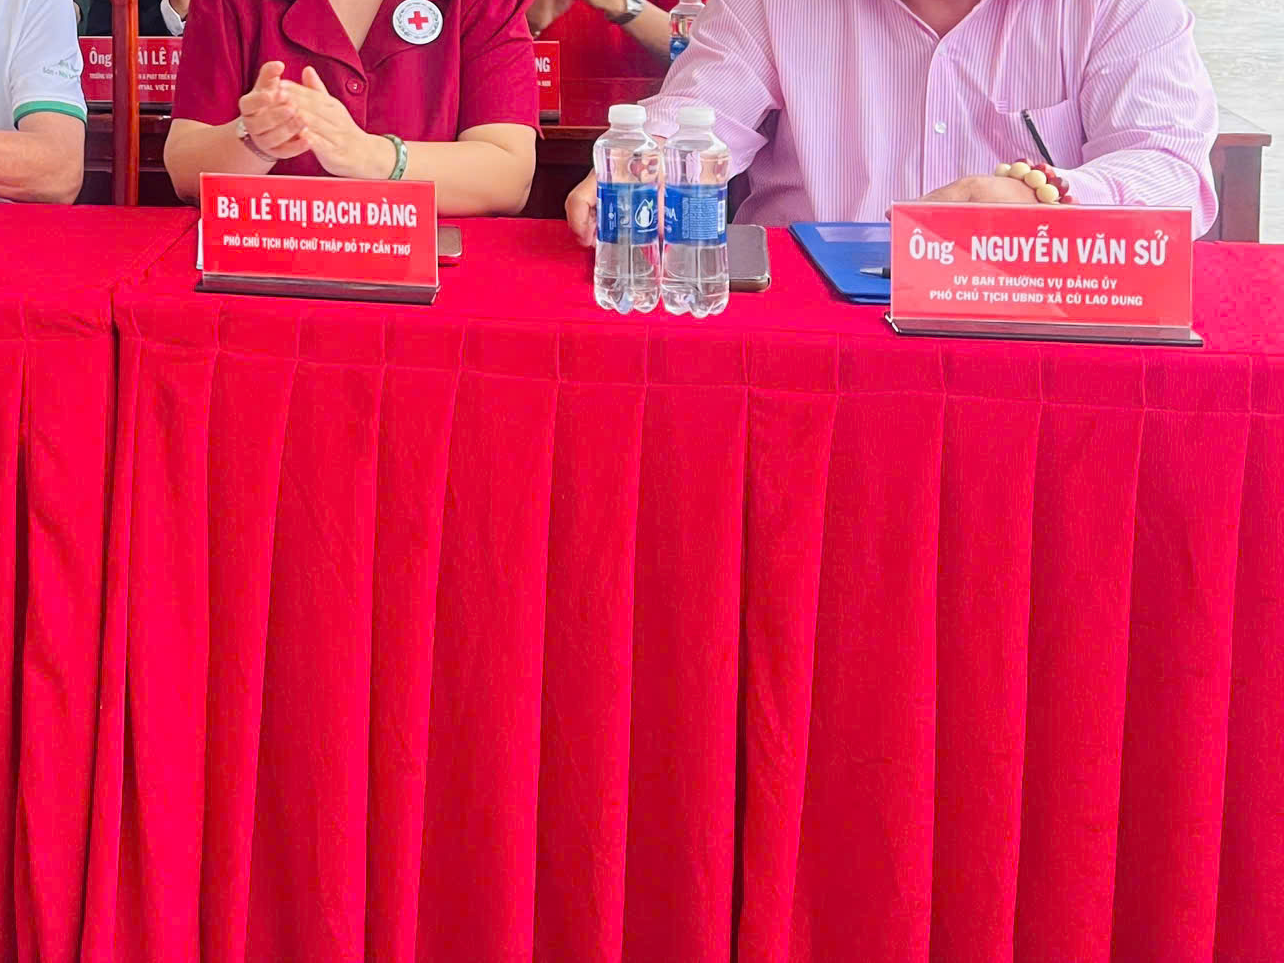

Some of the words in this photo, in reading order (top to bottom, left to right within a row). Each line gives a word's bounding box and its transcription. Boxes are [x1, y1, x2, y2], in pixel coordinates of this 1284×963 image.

[89, 46, 113, 67] Ông
[151, 46, 167, 65] LÊ
[217, 196, 239, 218] Bà
[251, 192, 272, 220] LÊ
[278, 199, 307, 228] THỊ
[312, 200, 361, 228] BẠCH
[367, 197, 417, 227] ĐÀNG
[223, 233, 241, 246] PHÓ
[242, 233, 260, 248] CHỦ
[262, 237, 282, 250] TỊCH
[283, 236, 298, 251] HỘI
[299, 237, 318, 251] CHỮ
[319, 238, 343, 253] THẬP
[344, 238, 357, 253] ĐỎ
[359, 241, 371, 254] TP
[392, 243, 411, 256] THƠ
[909, 228, 955, 264] Ông
[971, 224, 1068, 264] NGUYỄN
[1076, 233, 1126, 265] VĂN
[1133, 229, 1169, 266] SỬ
[972, 276, 995, 286] BAN
[998, 275, 1044, 288] THƯỜNG
[1047, 277, 1063, 290] VỤ
[1066, 275, 1099, 289] ĐẢNG
[1102, 276, 1117, 290] ỦY
[929, 289, 952, 301] PHÓ
[956, 288, 979, 301] CHỦ
[982, 291, 1008, 304] TỊCH
[1012, 292, 1044, 303] UBND
[1047, 291, 1063, 304] XÃ
[1066, 292, 1082, 304] CÙ
[1085, 294, 1108, 305] LAO
[1111, 295, 1143, 306] DUNG
